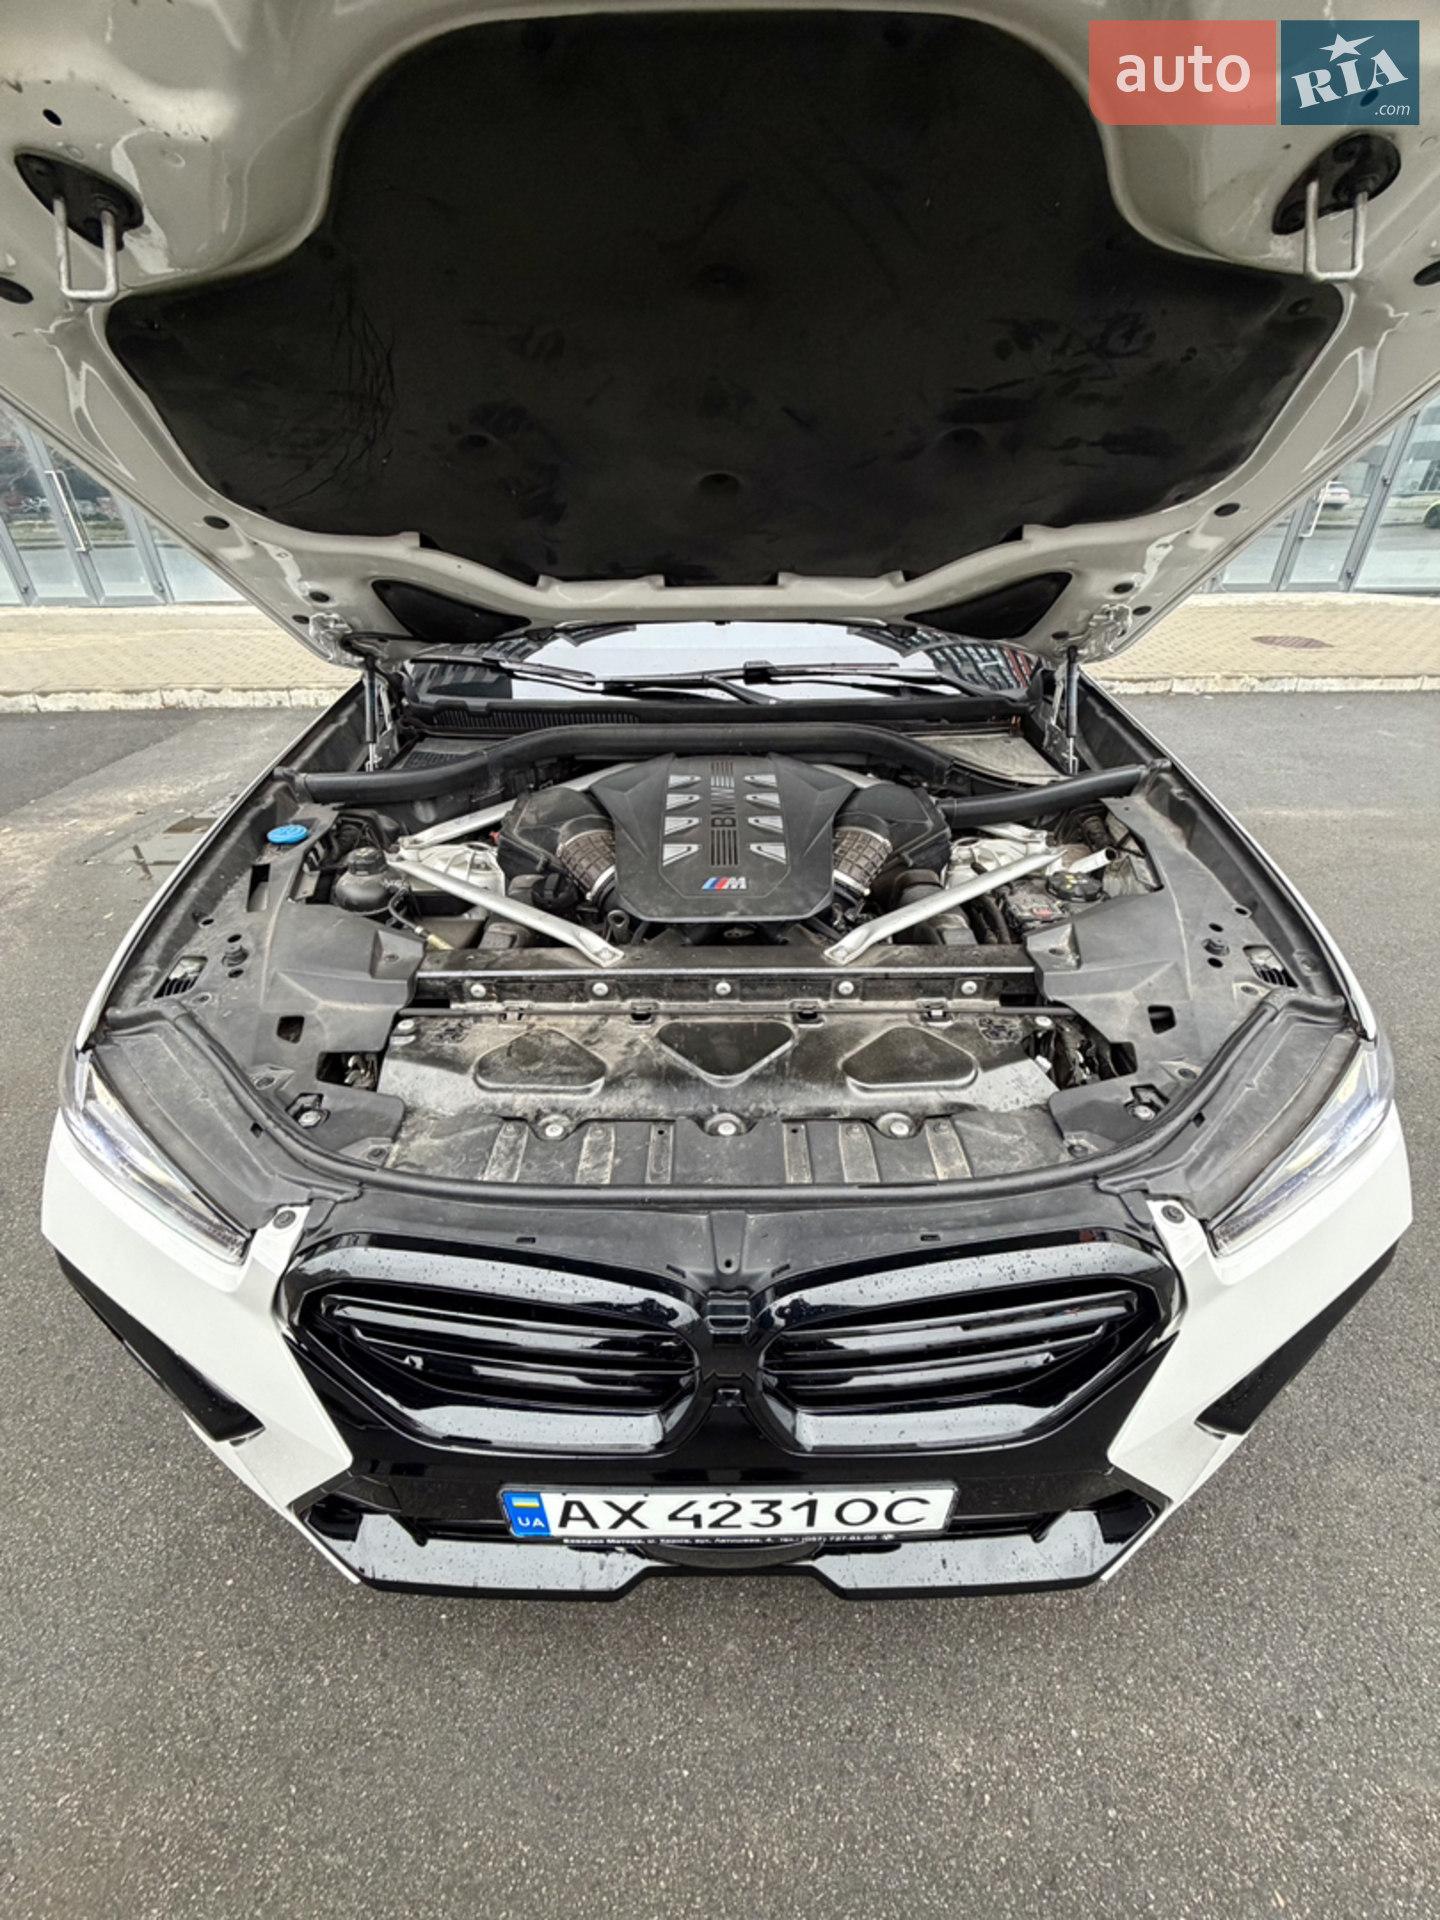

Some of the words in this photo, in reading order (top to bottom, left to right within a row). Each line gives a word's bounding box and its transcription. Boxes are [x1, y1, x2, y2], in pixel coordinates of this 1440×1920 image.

[711, 787, 736, 828] BMW
[517, 1516, 546, 1528] UA
[558, 1499, 650, 1529] AX
[667, 1499, 818, 1529] 4231
[835, 1497, 931, 1526] OC
